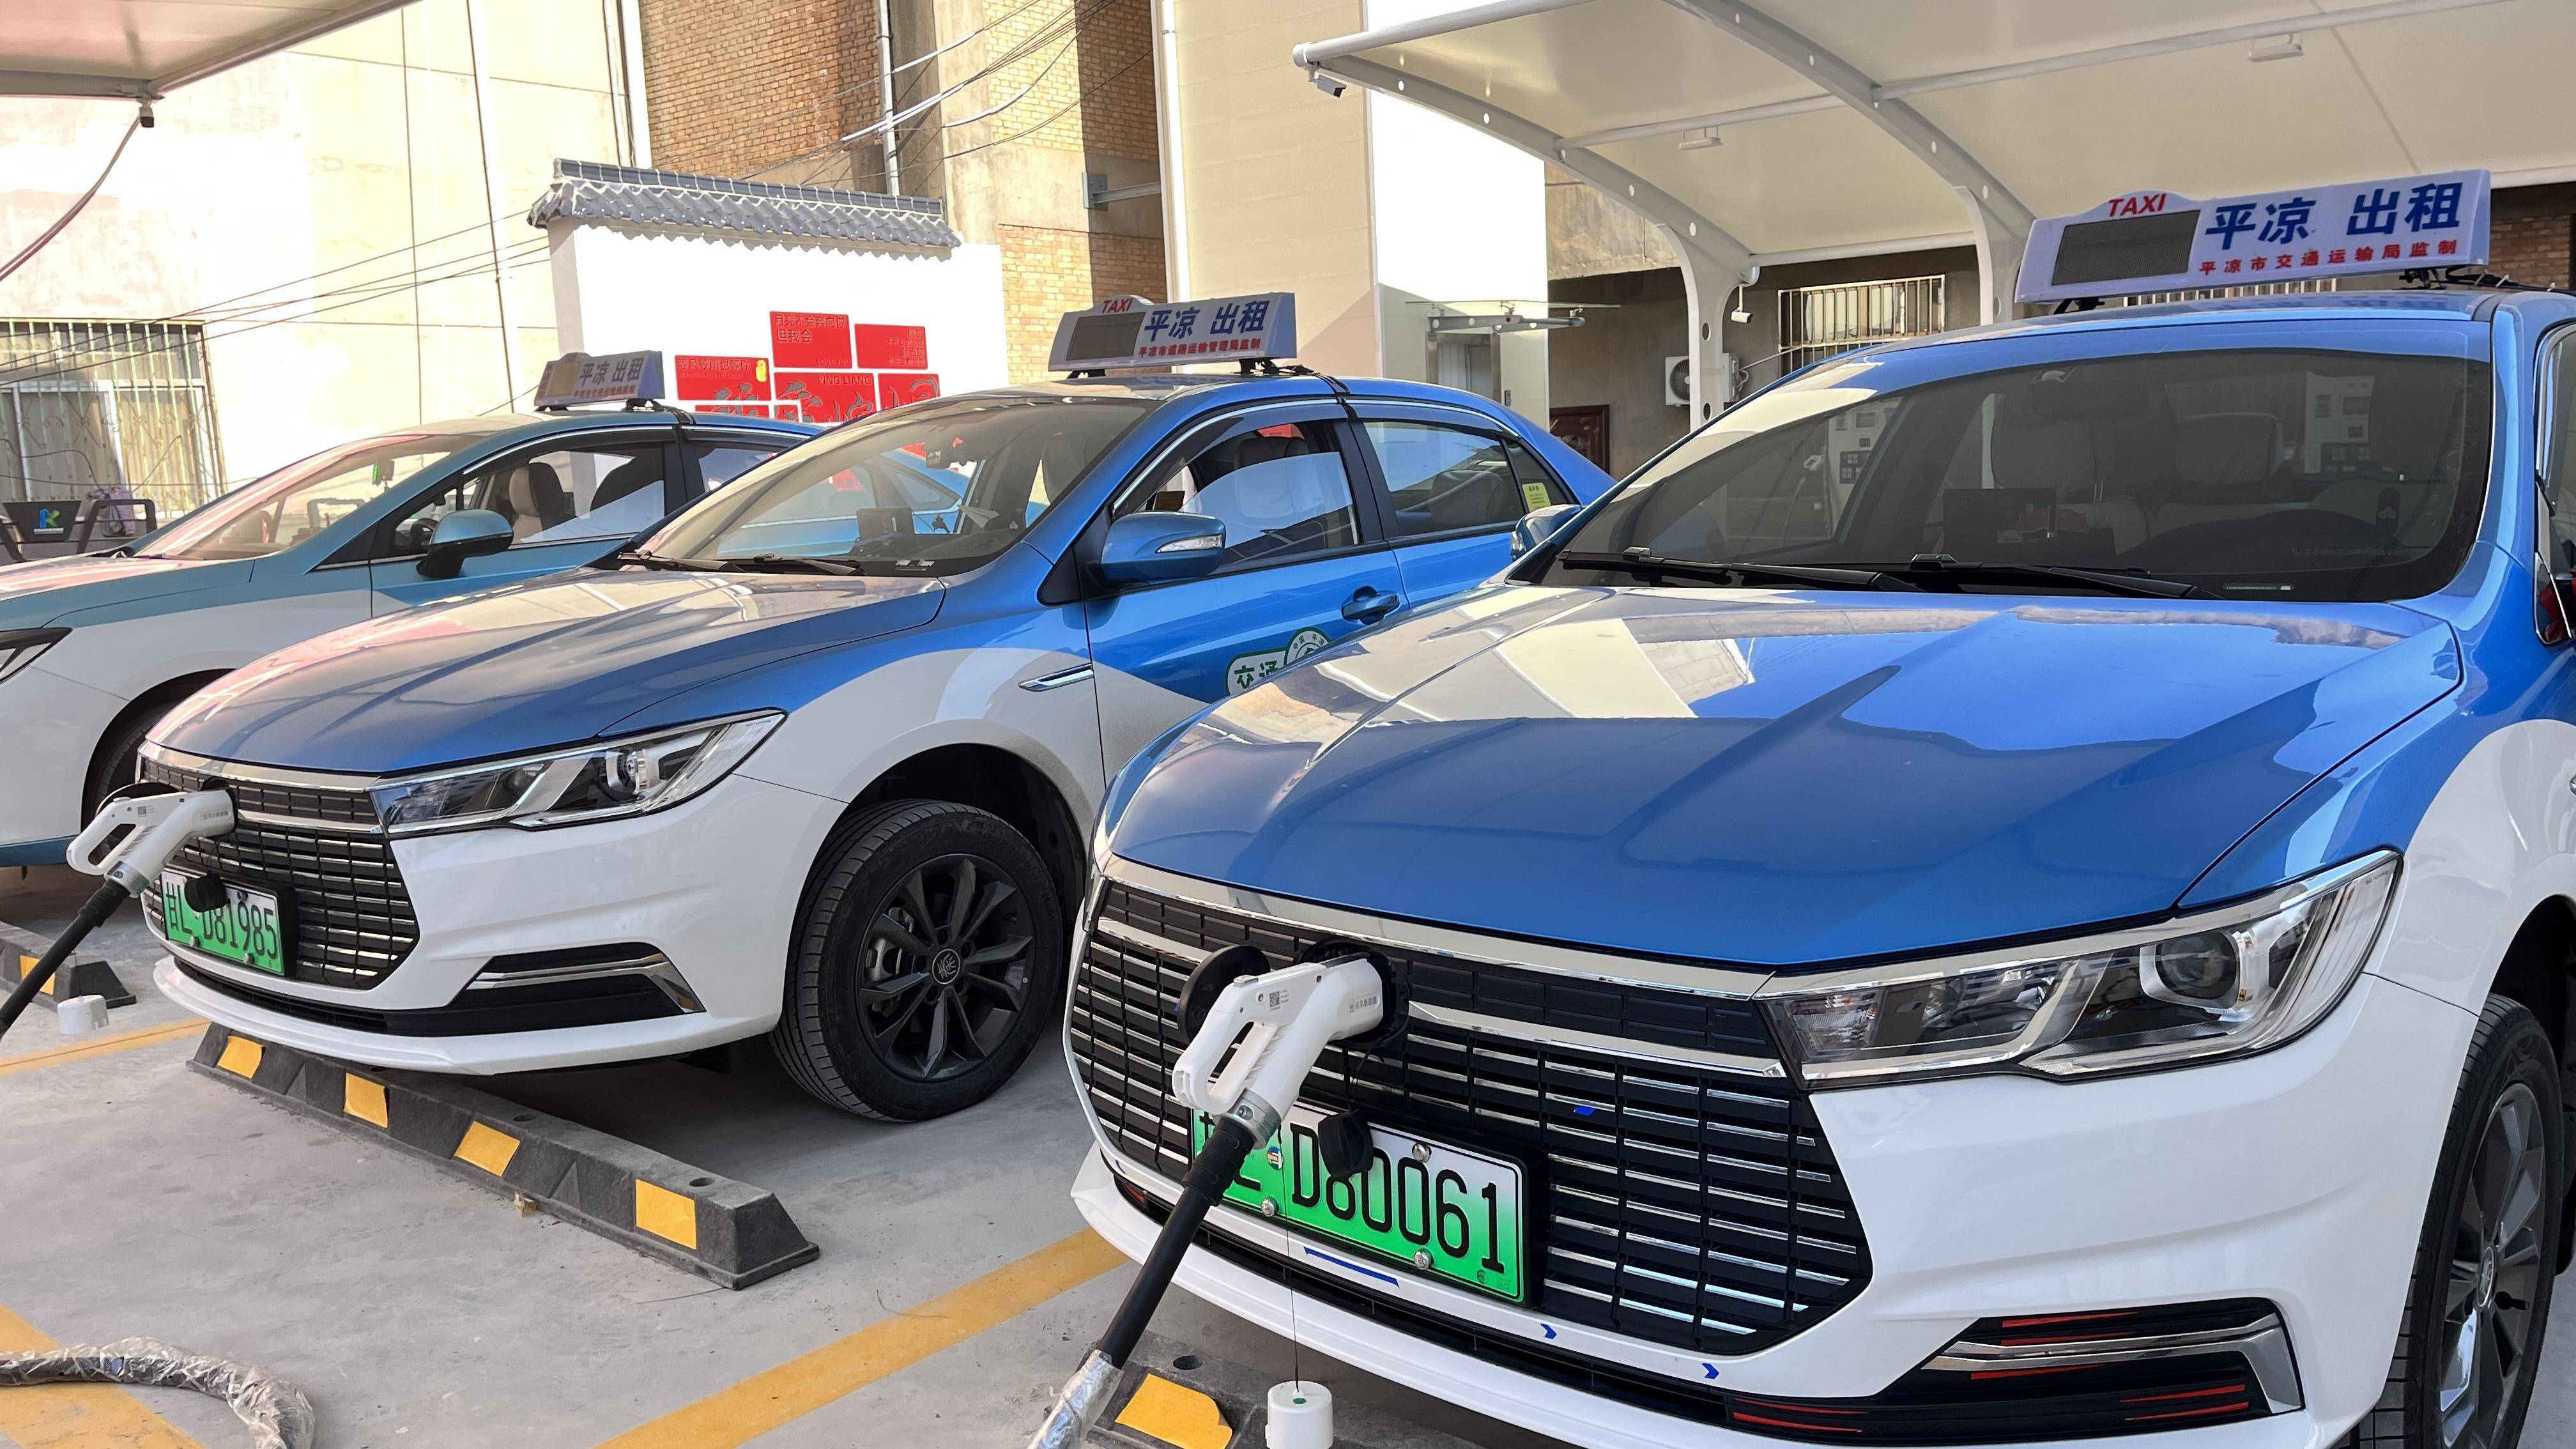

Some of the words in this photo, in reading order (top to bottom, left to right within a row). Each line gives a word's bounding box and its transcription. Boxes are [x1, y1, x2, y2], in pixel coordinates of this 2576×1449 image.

[2108, 193, 2167, 217] TAXI
[2205, 196, 2316, 250] 平凉
[2346, 182, 2464, 236] 出租
[2198, 239, 2458, 276] 平凉市交通运输局监制
[1101, 298, 1132, 313] TAXI
[1144, 307, 1200, 342] 平凉
[1209, 300, 1271, 335] 出租
[776, 328, 811, 342] 但我会
[1138, 338, 1261, 358] 平凉市道路运输管理局监制
[579, 362, 610, 387] 平凉
[611, 357, 645, 383] 出租
[817, 376, 840, 385] PING
[843, 376, 871, 385] LIANG
